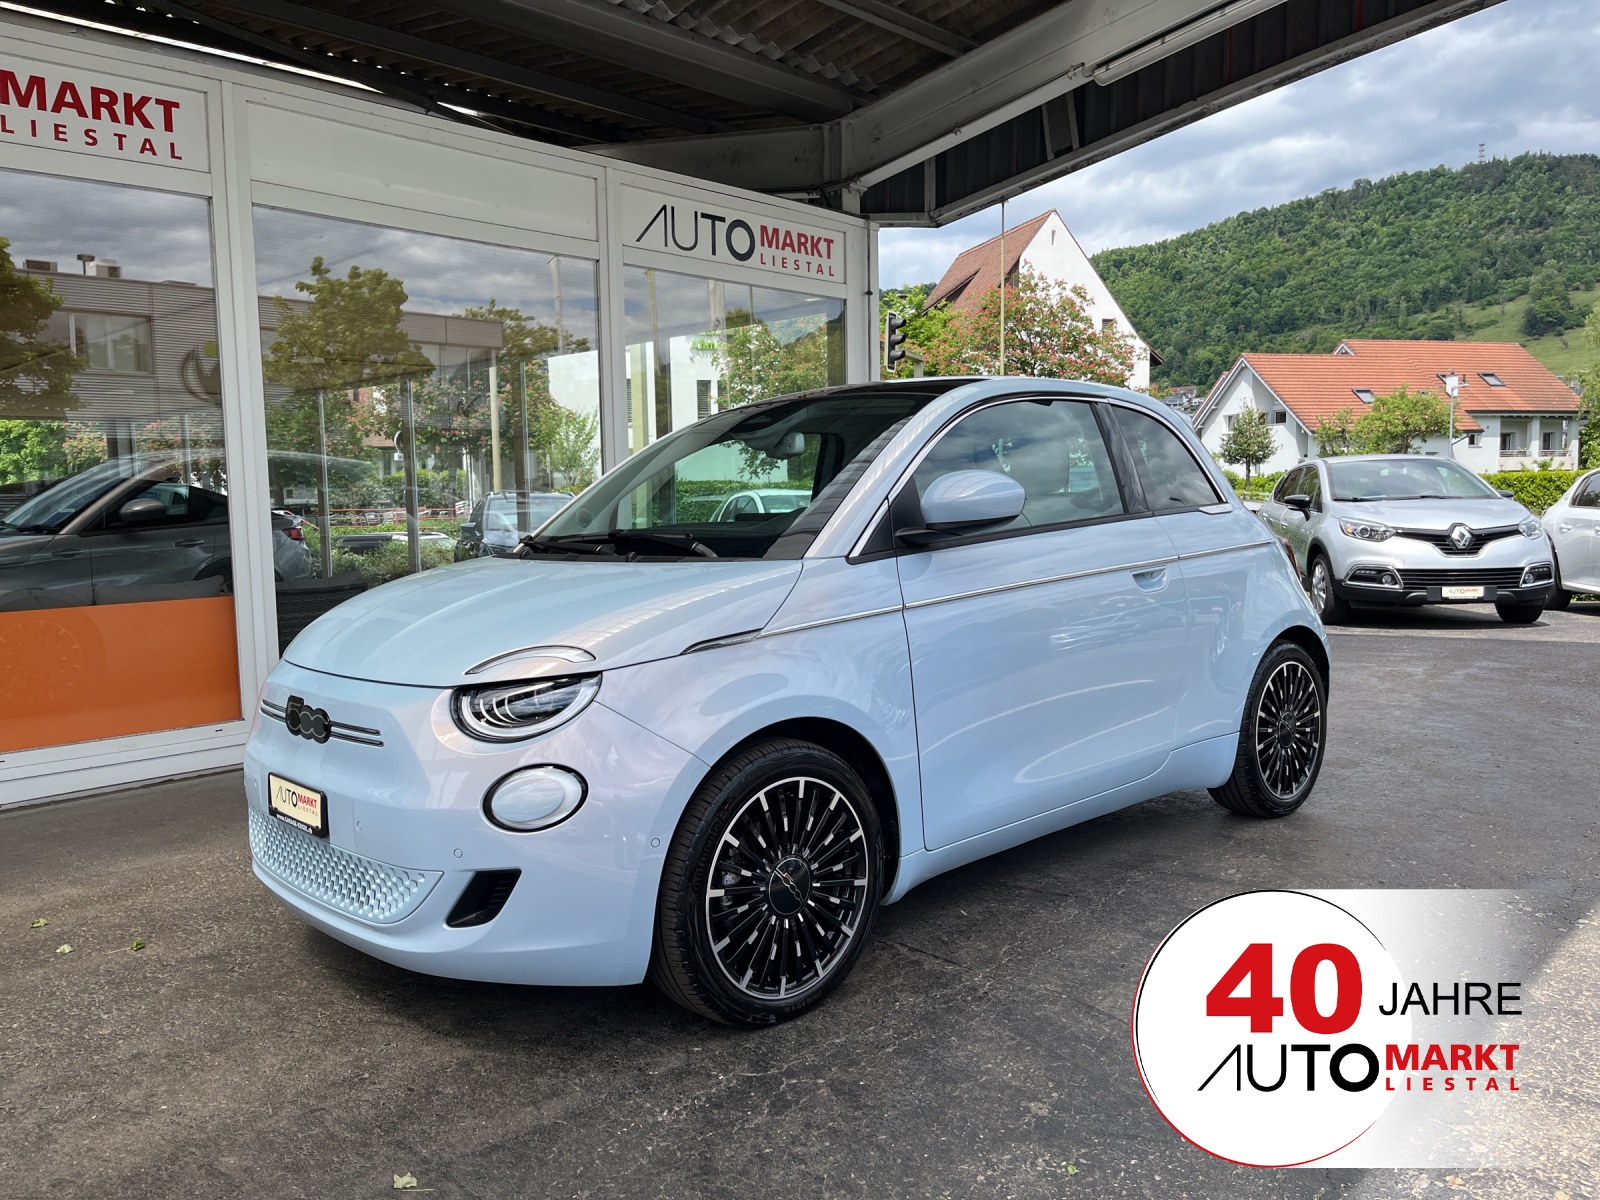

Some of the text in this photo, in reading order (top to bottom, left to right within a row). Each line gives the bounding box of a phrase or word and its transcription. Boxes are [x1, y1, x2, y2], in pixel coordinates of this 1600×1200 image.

[0, 69, 180, 133] MARKT
[0, 114, 182, 160] LIESTAL
[635, 203, 835, 263] AUTO MARKT
[760, 252, 835, 277] LIESTAL
[275, 785, 318, 809] AUTO MARKT
